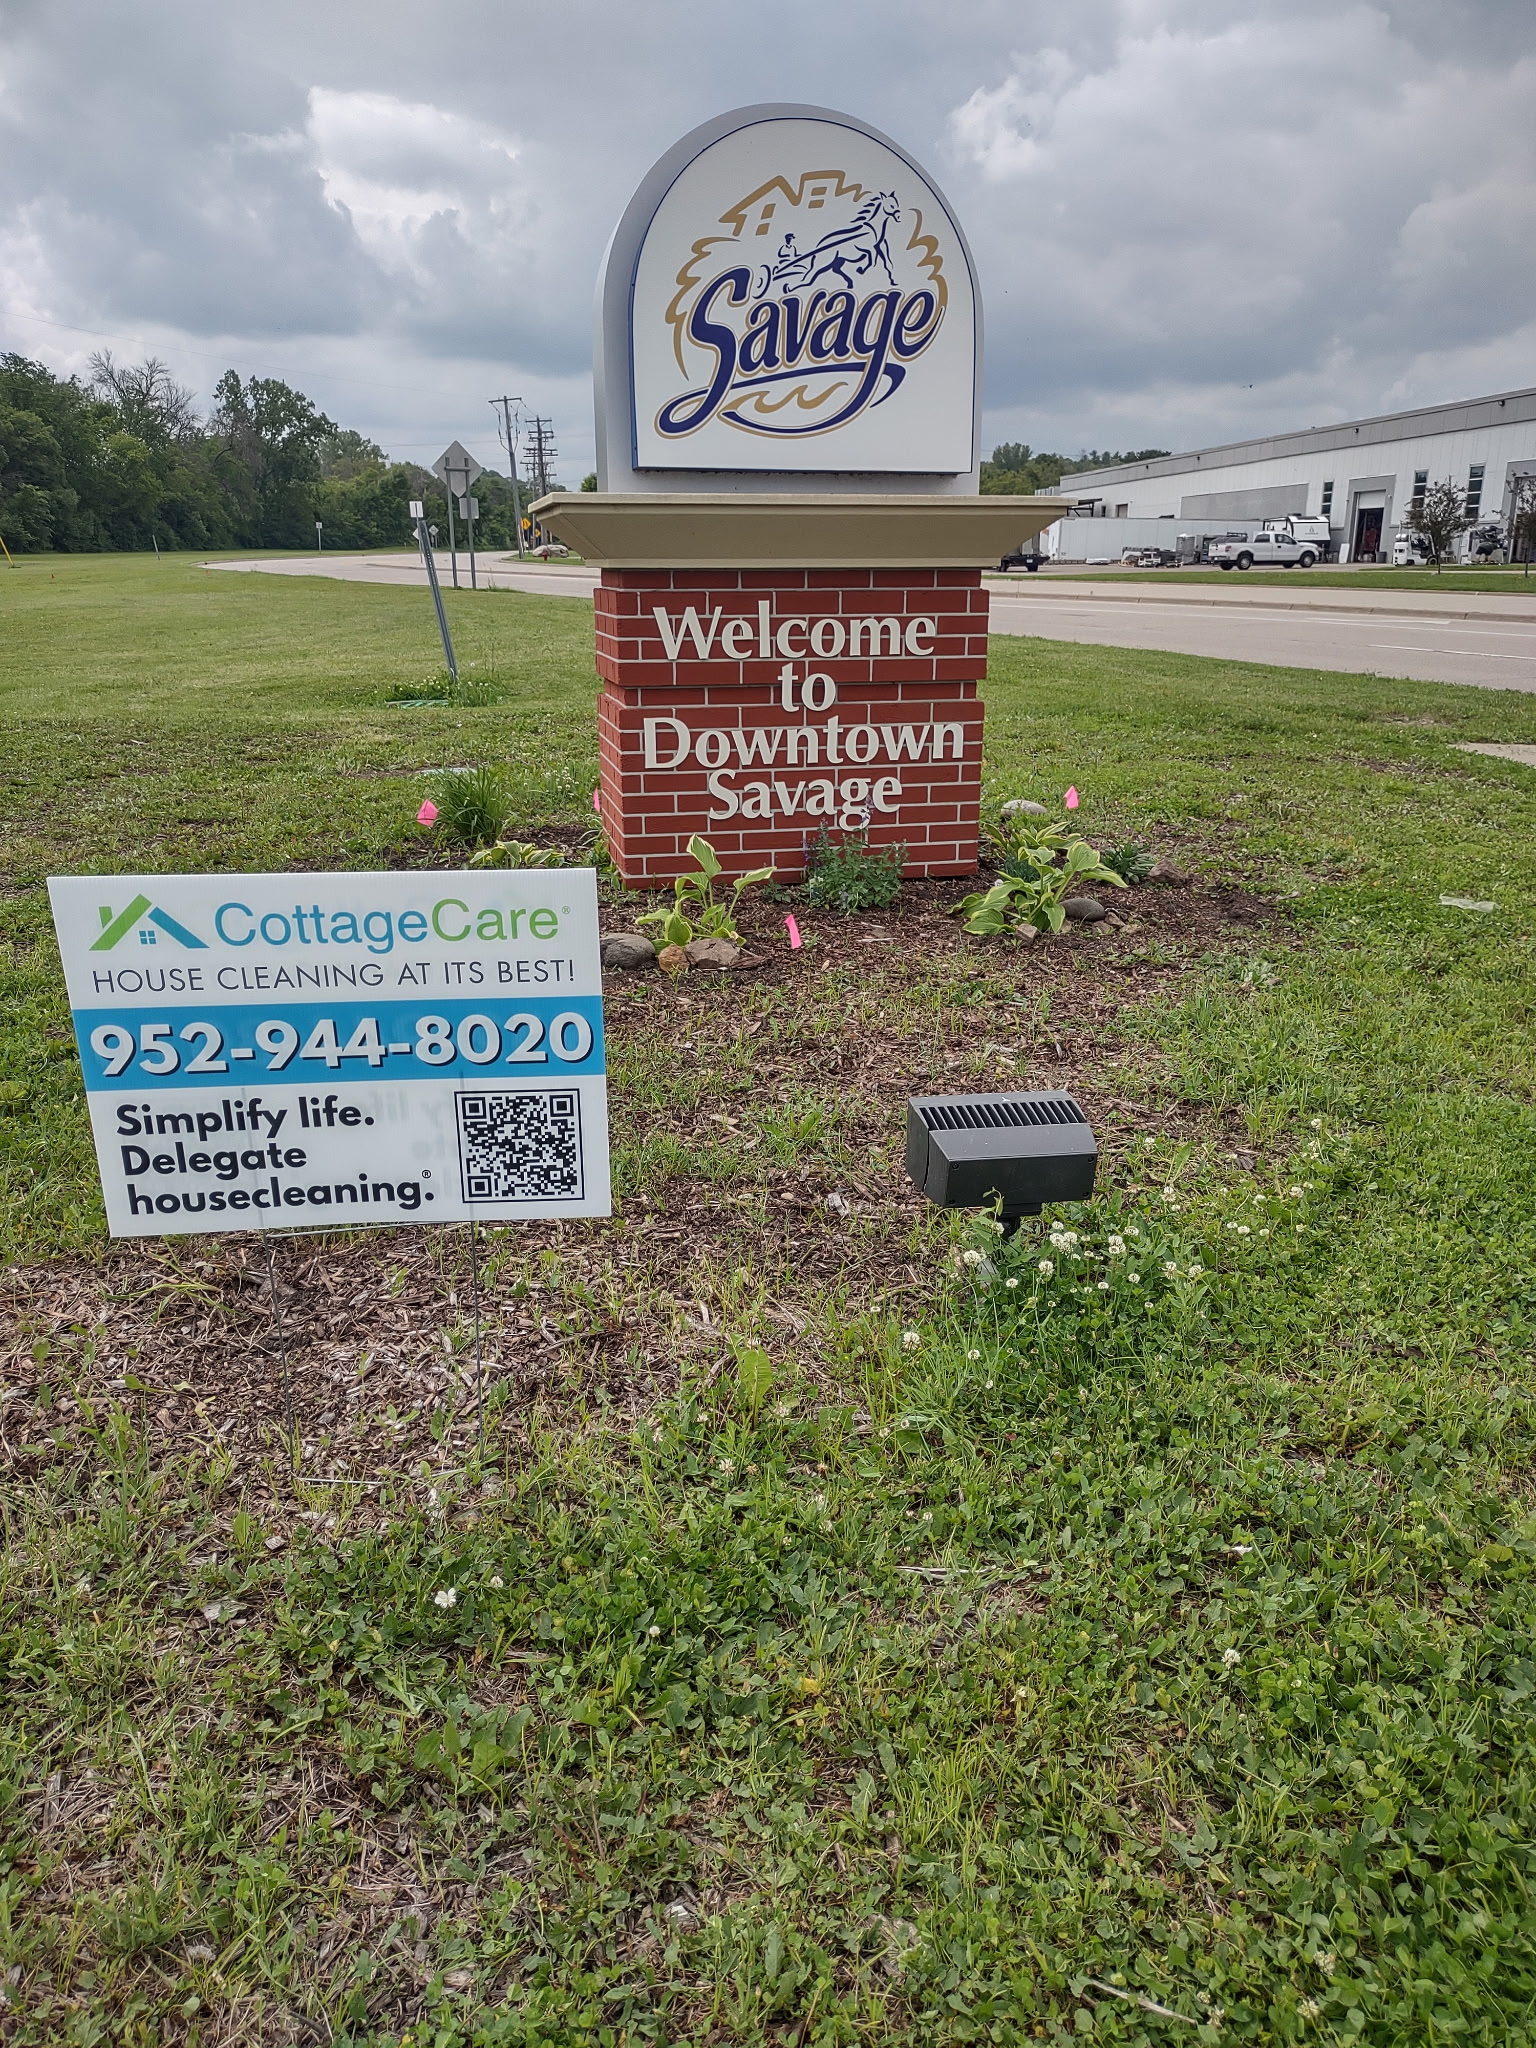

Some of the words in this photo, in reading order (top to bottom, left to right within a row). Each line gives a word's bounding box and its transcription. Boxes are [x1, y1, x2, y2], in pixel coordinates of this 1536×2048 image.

[655, 265, 945, 437] Savage
[652, 600, 936, 660] Welcome
[777, 662, 837, 712] to
[643, 715, 964, 769] Downtown
[708, 768, 903, 832] Savage
[93, 967, 205, 994] HOUSE
[216, 963, 385, 990] CLEANING
[397, 962, 431, 986] AT
[443, 960, 484, 984] ITS
[498, 959, 574, 983] BEST!
[90, 1012, 594, 1077] 952-944-8020
[116, 1099, 288, 1142] Simplify
[300, 1095, 375, 1128] life.
[121, 1144, 307, 1181] Delegate
